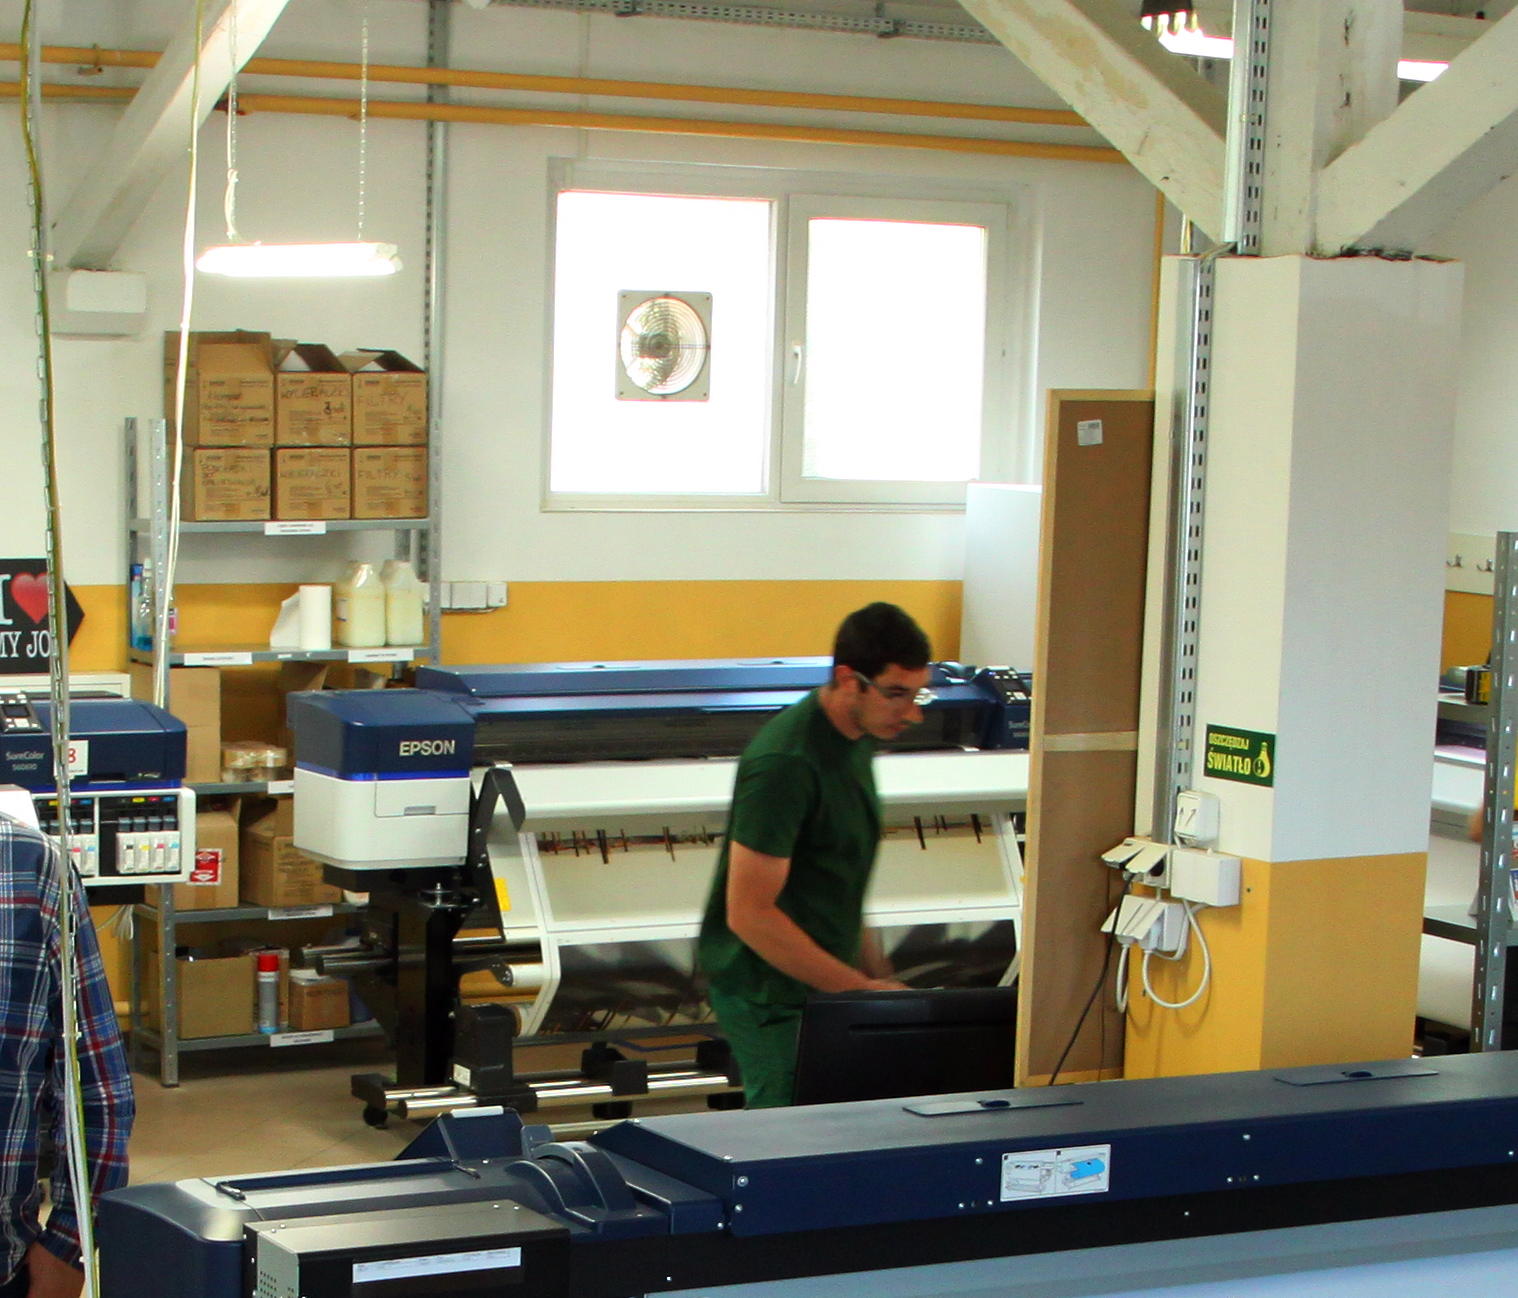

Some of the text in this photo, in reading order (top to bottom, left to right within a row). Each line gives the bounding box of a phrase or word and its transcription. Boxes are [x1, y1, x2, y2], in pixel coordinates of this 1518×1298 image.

[26, 630, 51, 658] JO
[399, 740, 455, 756] EPSON
[1207, 746, 1251, 776] ŚWIATŁO
